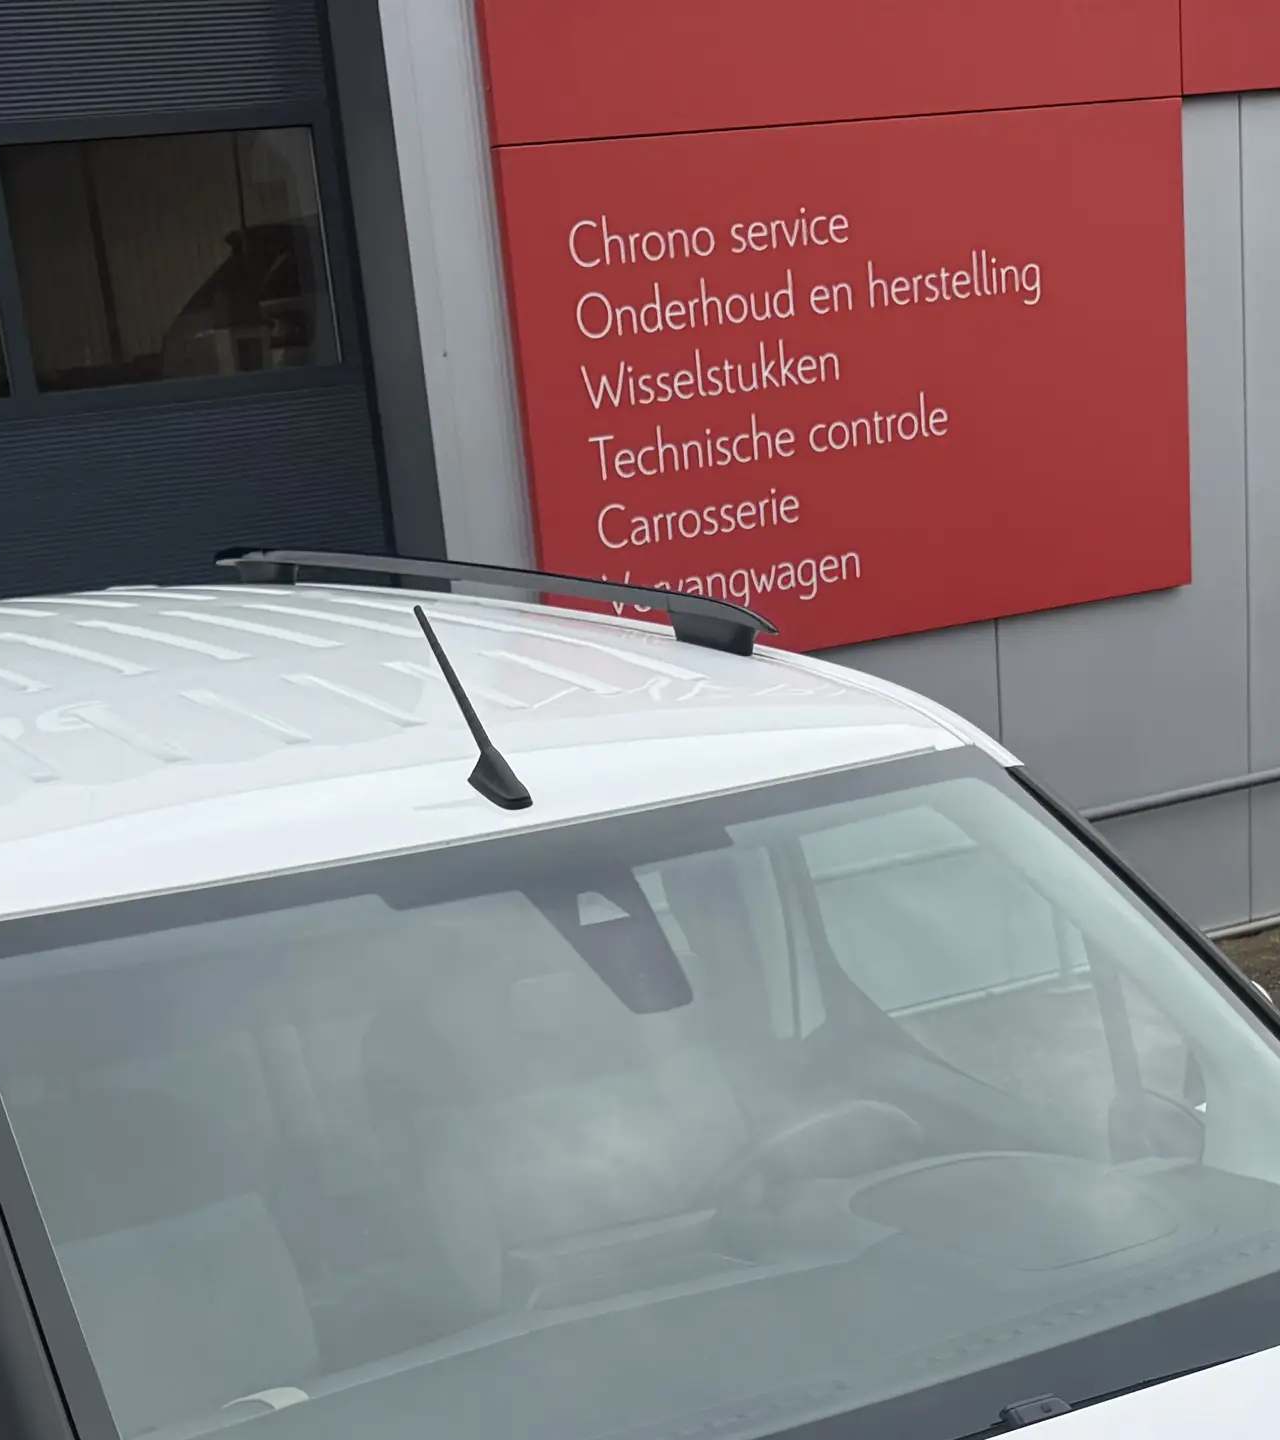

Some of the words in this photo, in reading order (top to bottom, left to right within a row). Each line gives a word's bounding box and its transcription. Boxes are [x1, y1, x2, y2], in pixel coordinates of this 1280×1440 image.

[569, 215, 716, 268] Chrono
[730, 207, 849, 254] service
[576, 268, 795, 339] Onderhoud
[809, 282, 853, 315] en
[867, 249, 1041, 306] herstelling
[580, 338, 840, 410] Wisselstukken
[588, 413, 795, 481] Technische
[808, 390, 949, 453] controle
[597, 487, 800, 549] Carrosserie
